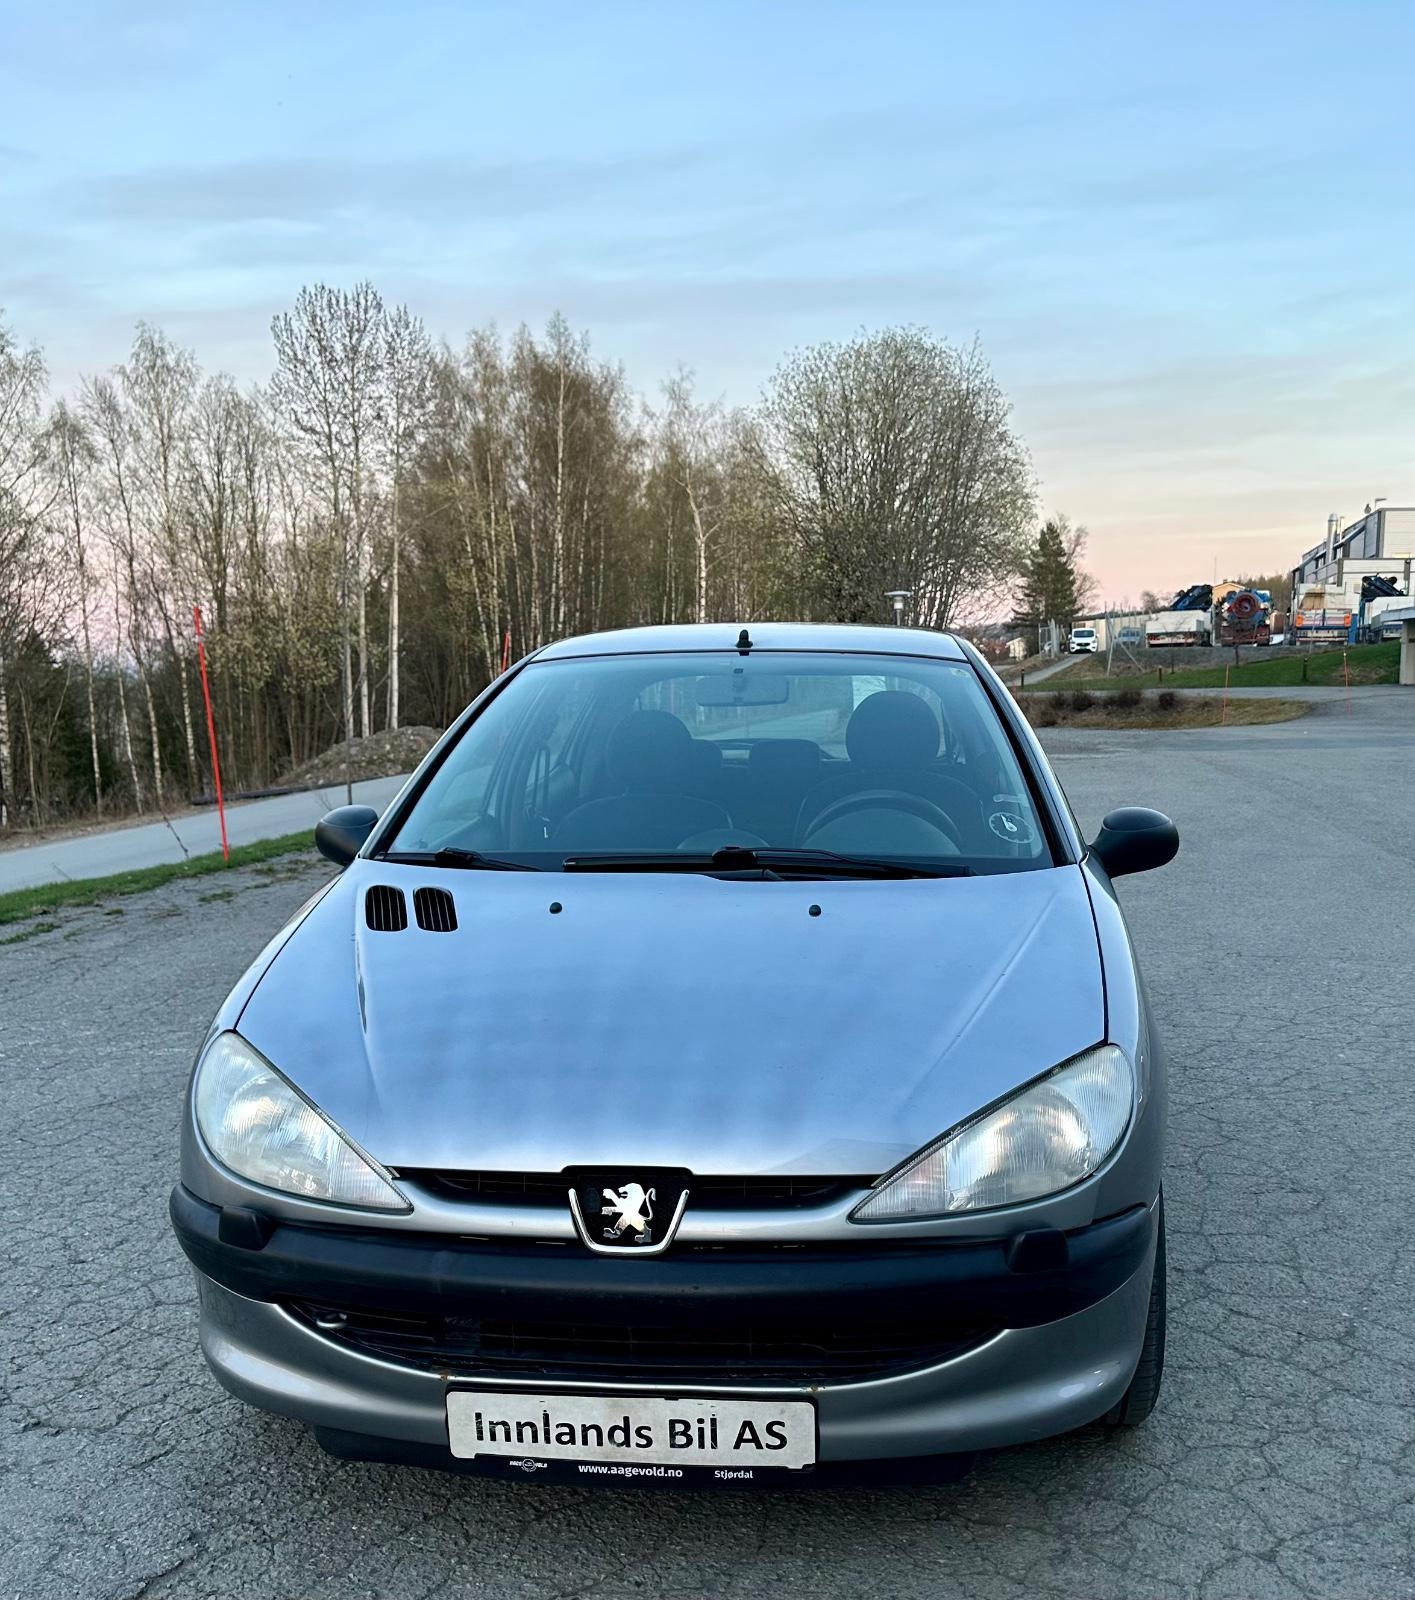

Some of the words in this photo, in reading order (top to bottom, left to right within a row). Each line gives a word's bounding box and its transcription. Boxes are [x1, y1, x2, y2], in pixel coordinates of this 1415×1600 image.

[474, 1409, 653, 1450] Innlands
[668, 1413, 719, 1450] Bil
[733, 1420, 788, 1450] AS
[578, 1464, 683, 1478] www.aagevold.no
[714, 1469, 754, 1480] Stjørdal
